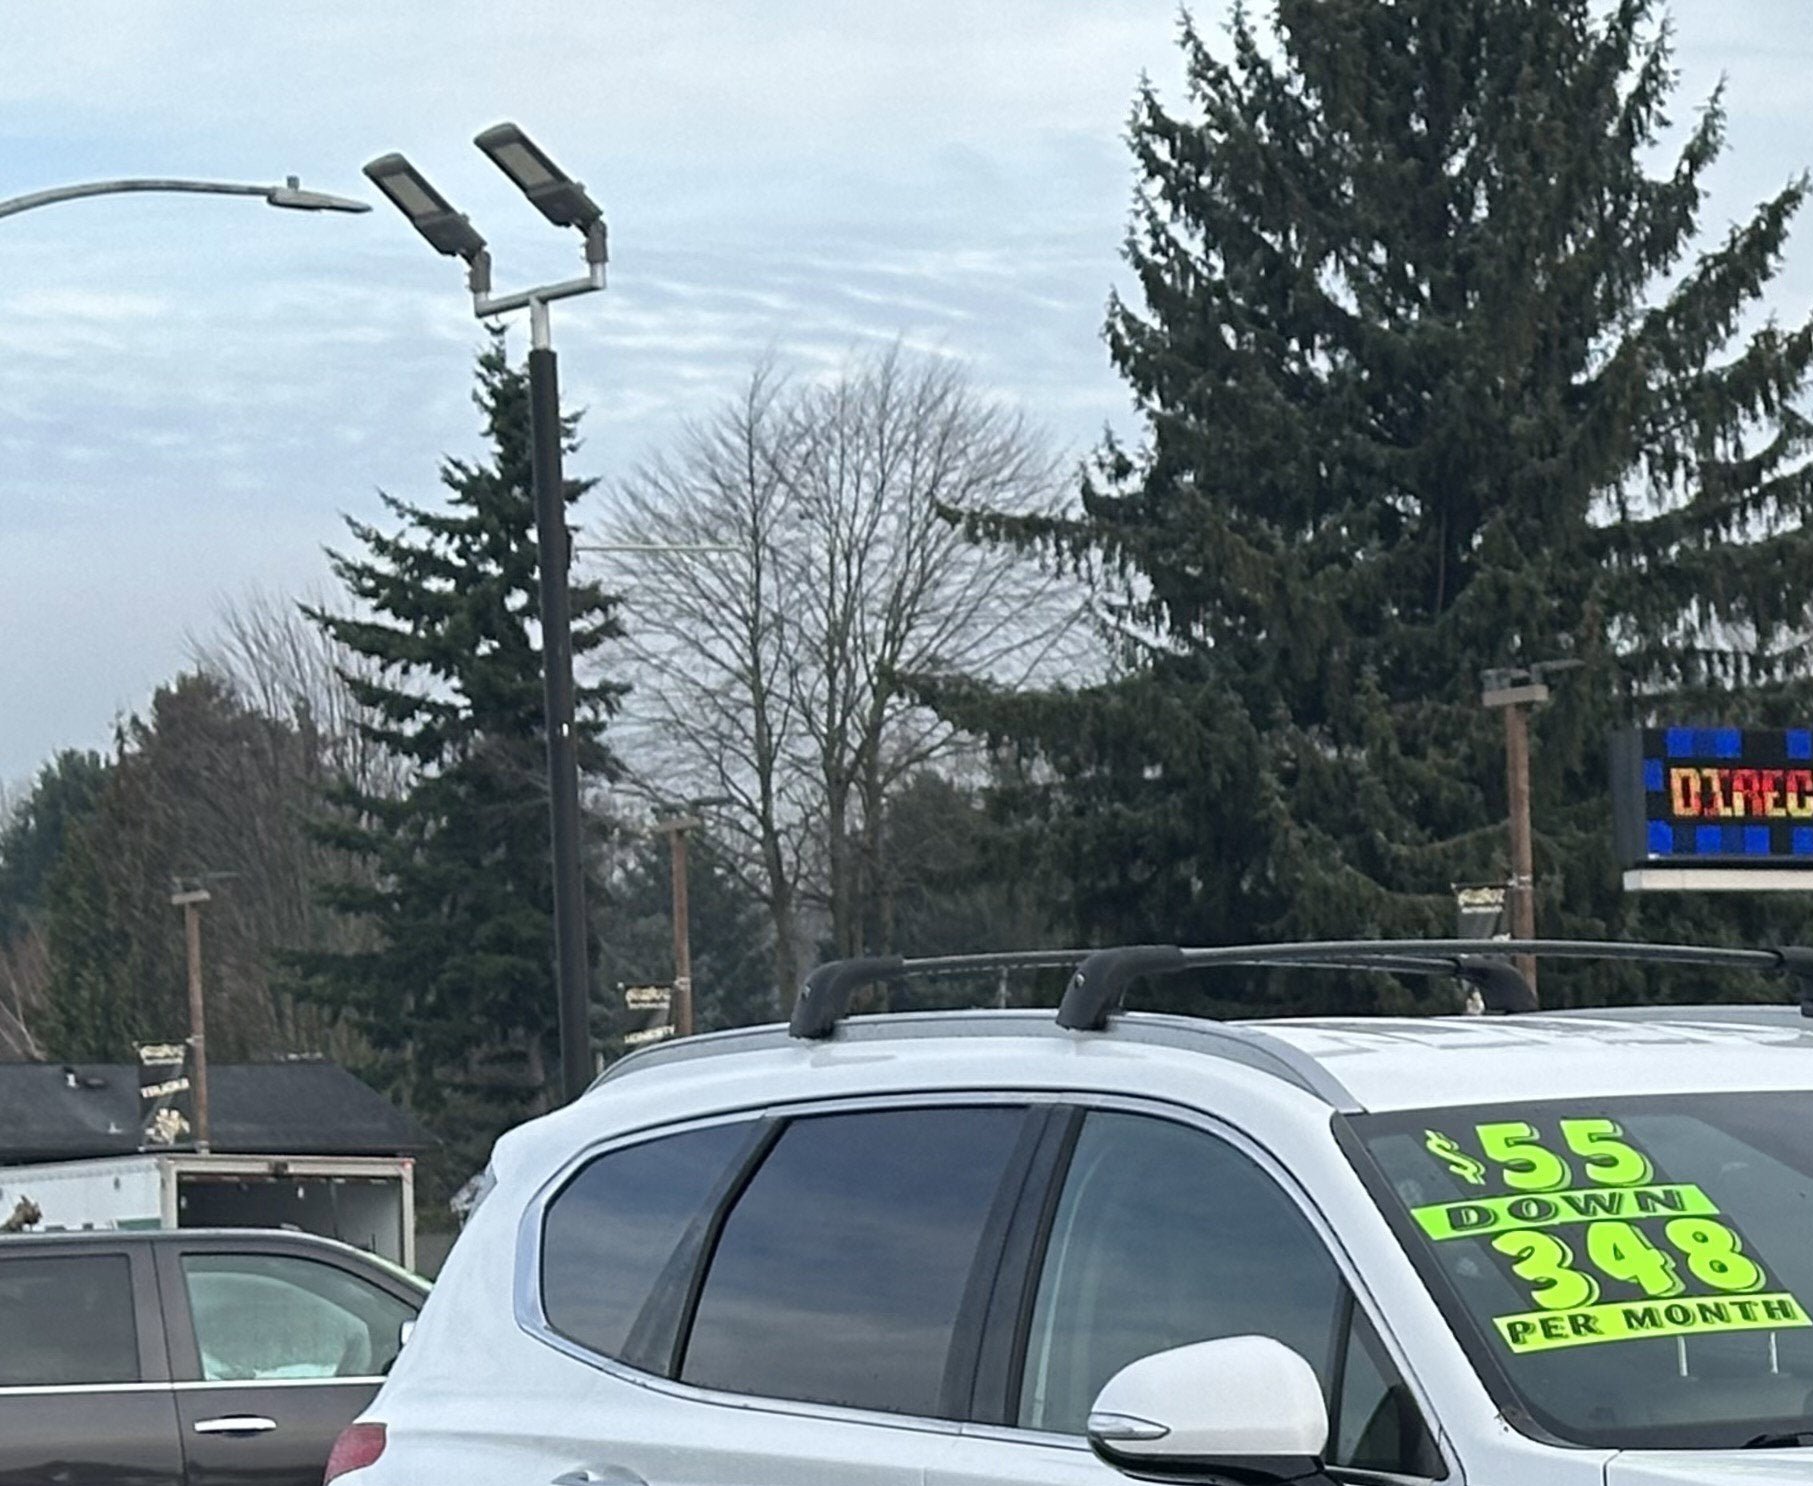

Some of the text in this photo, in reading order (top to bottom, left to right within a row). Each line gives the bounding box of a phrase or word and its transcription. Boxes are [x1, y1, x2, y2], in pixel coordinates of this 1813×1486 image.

[1446, 1189, 1686, 1231] DOWN
[1491, 1217, 1767, 1310] 348
[1506, 1298, 1797, 1345] PER MONTH
